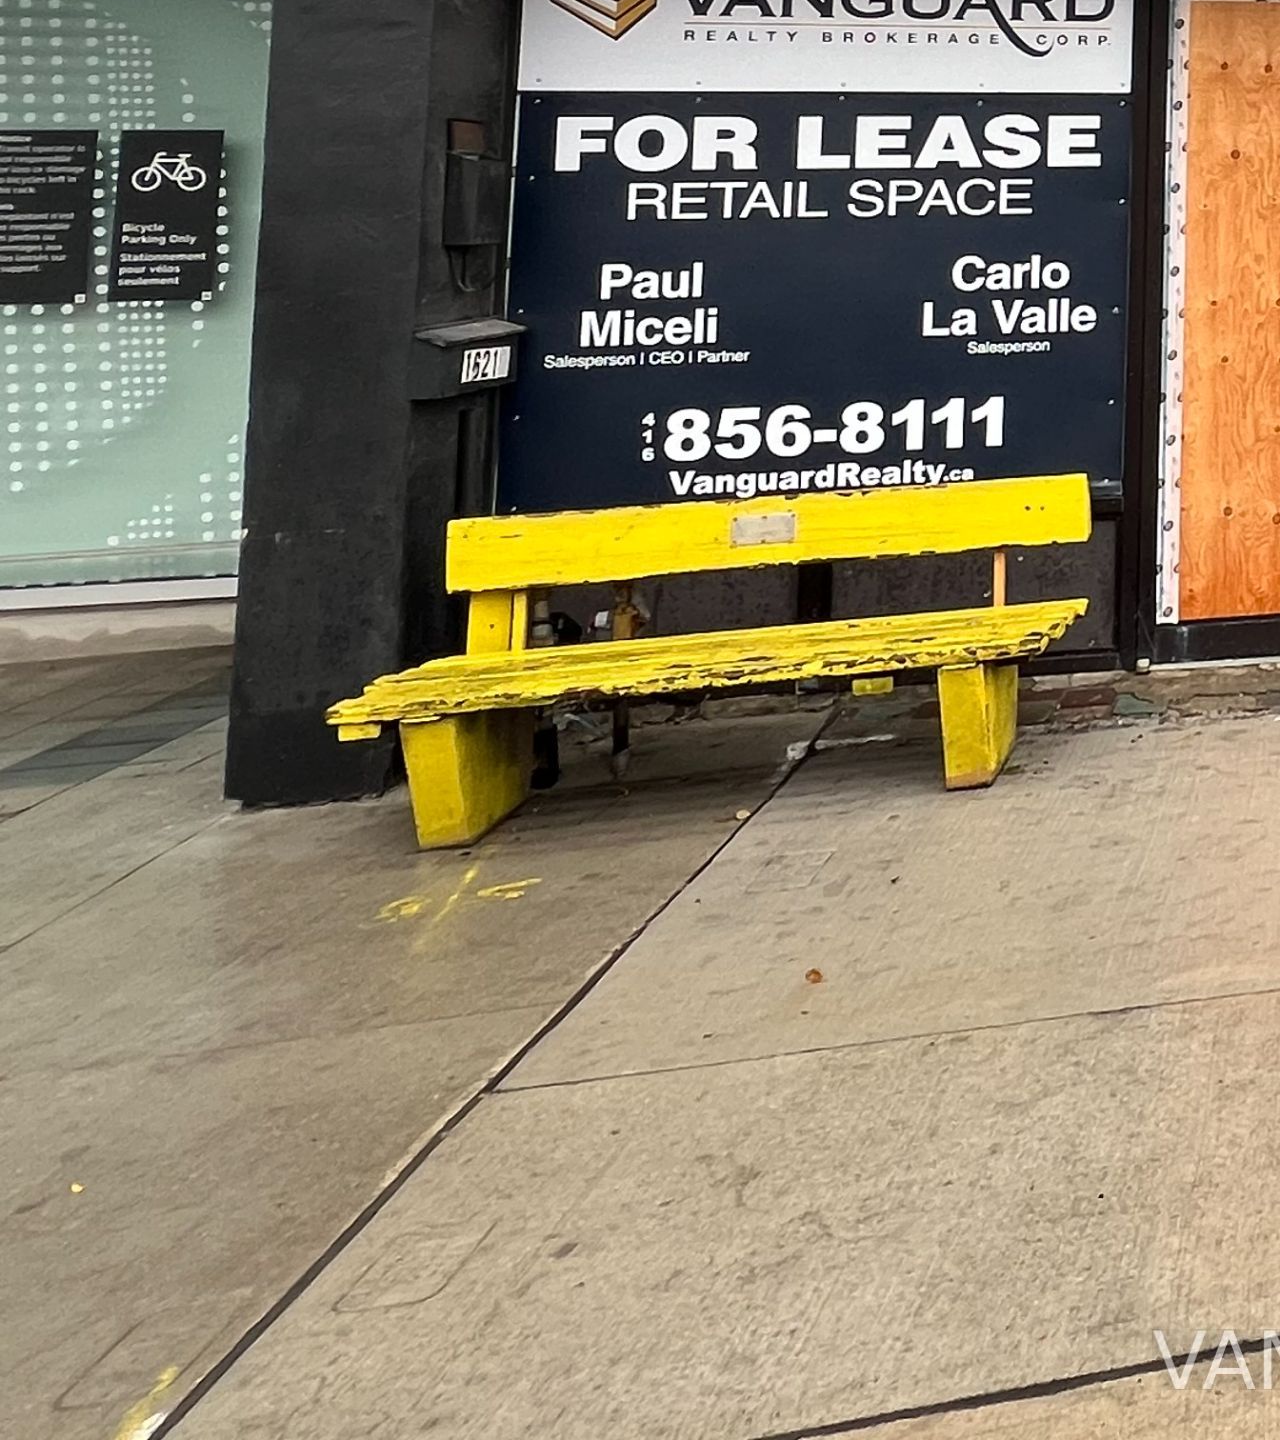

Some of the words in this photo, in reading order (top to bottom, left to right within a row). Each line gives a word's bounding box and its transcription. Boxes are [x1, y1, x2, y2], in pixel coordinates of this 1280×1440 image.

[684, 30, 798, 42] REALTY
[822, 31, 1001, 45] BROKERAGE
[1036, 33, 1112, 46] CORP.
[554, 115, 759, 172] FOR
[797, 113, 1102, 170] LEASE
[626, 180, 828, 221] RETAIL
[847, 178, 1033, 219] SPACE
[121, 235, 166, 245] Parking
[169, 235, 197, 245] Only
[122, 223, 165, 233] Bicycle
[600, 261, 705, 301] Paul
[951, 254, 1071, 294] Carlo
[579, 307, 720, 348] Miceli
[922, 302, 977, 339] La
[991, 298, 1098, 335] Valle
[465, 349, 499, 381] 1621
[543, 353, 636, 370] Salesperson
[649, 351, 685, 365] CEO
[697, 349, 750, 364] Partner
[967, 339, 1051, 356] Salesperson
[663, 395, 1006, 463] 856-8111
[669, 460, 975, 498] VanguardRealty.ca
